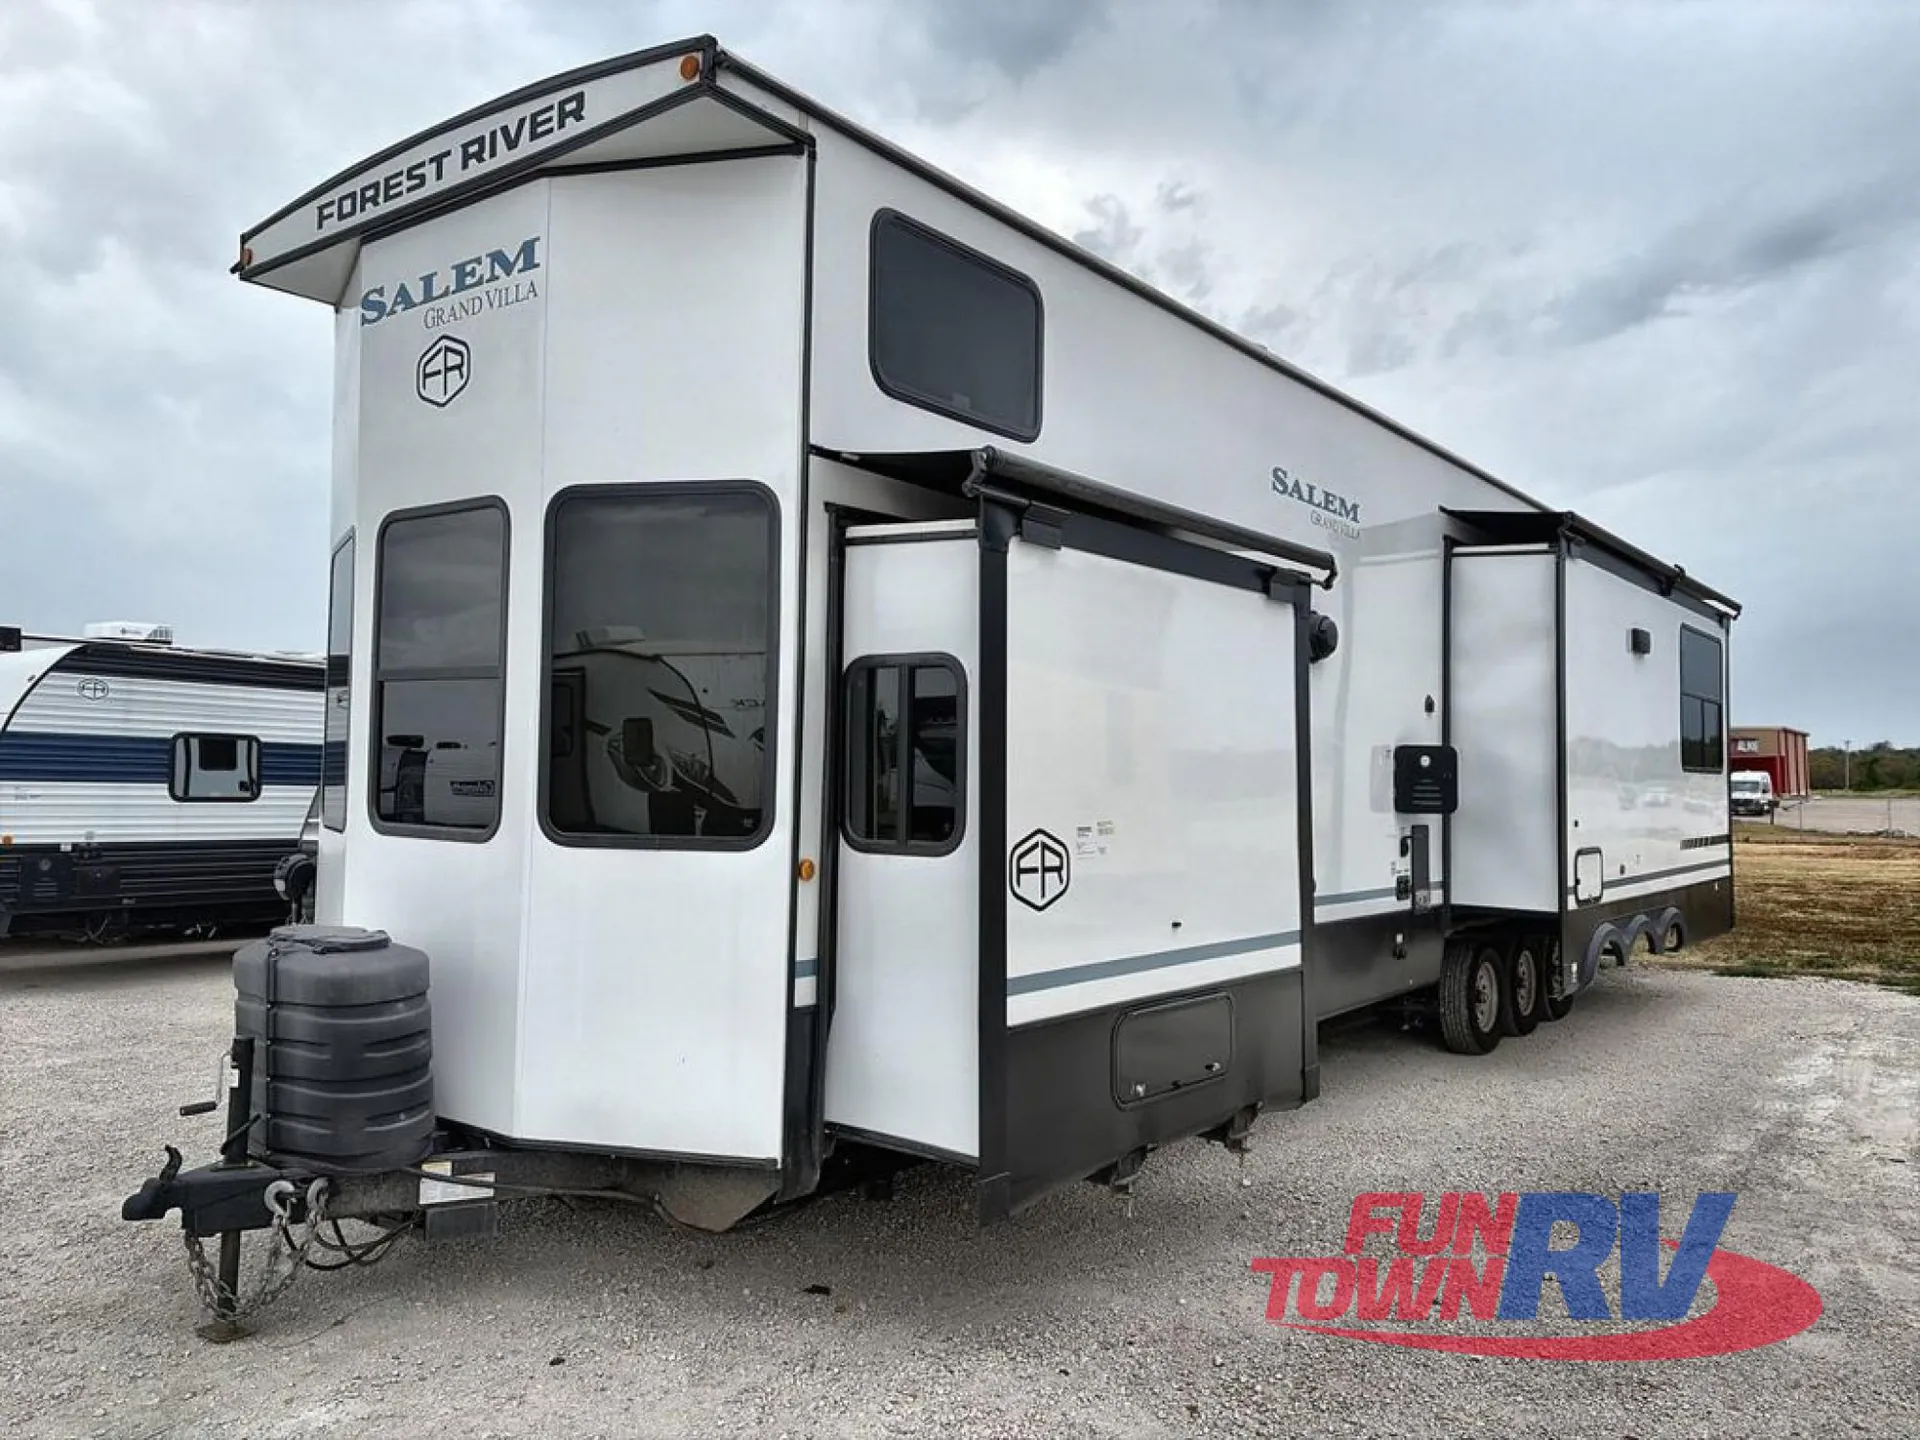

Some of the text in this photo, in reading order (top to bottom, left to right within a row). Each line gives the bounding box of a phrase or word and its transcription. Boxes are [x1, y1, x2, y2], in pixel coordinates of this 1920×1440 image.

[316, 90, 586, 231] FOREST RIVER
[360, 235, 541, 328] SALEM
[423, 280, 539, 329] GRAND VILLA
[1271, 466, 1361, 524] SALEM
